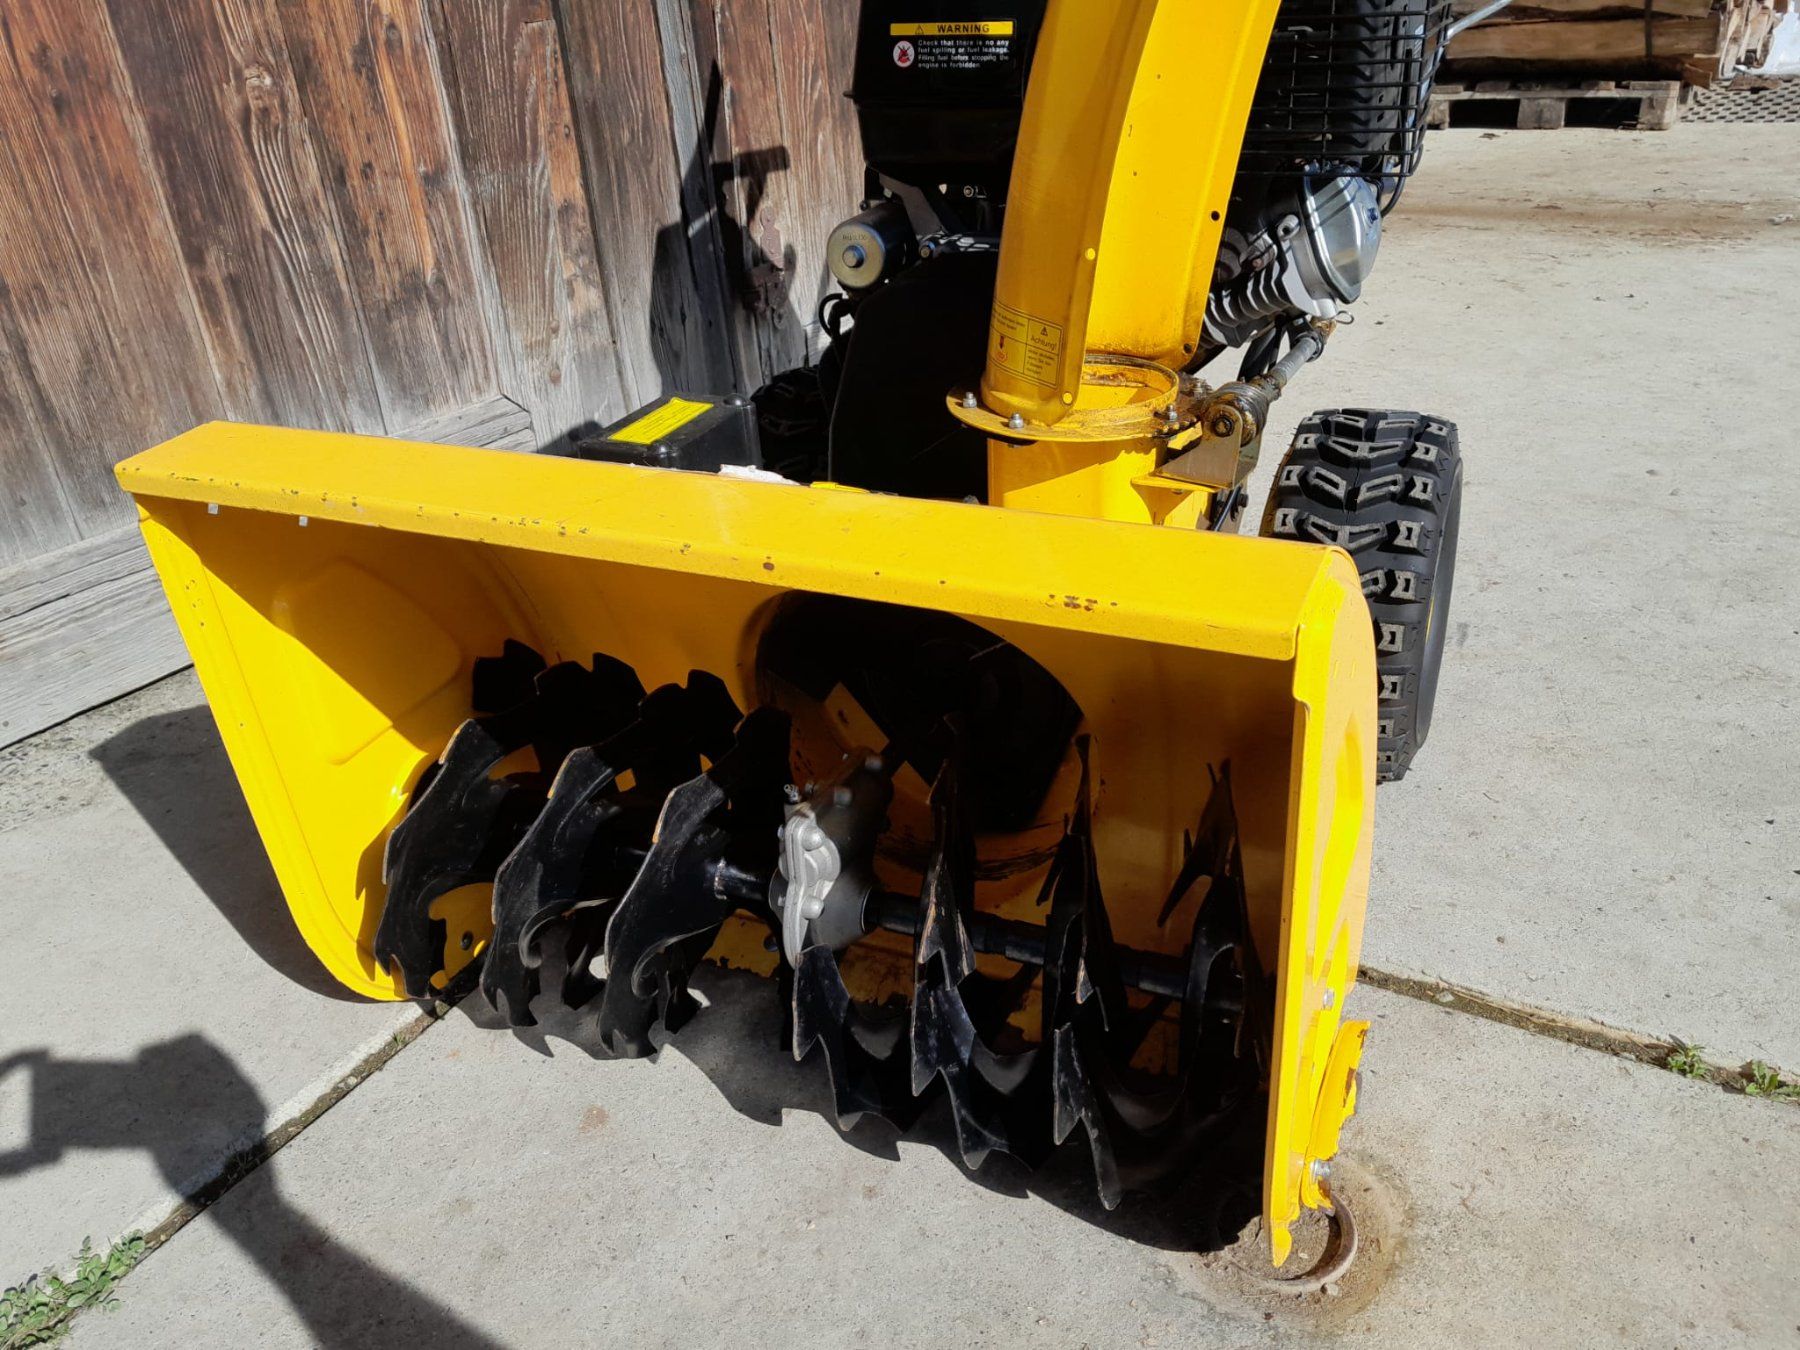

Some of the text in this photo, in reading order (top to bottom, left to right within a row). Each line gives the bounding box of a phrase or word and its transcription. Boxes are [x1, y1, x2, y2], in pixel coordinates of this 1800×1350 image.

[937, 23, 990, 34] WARNING
[997, 39, 1010, 47] any
[1030, 335, 1057, 351] Achtung!
